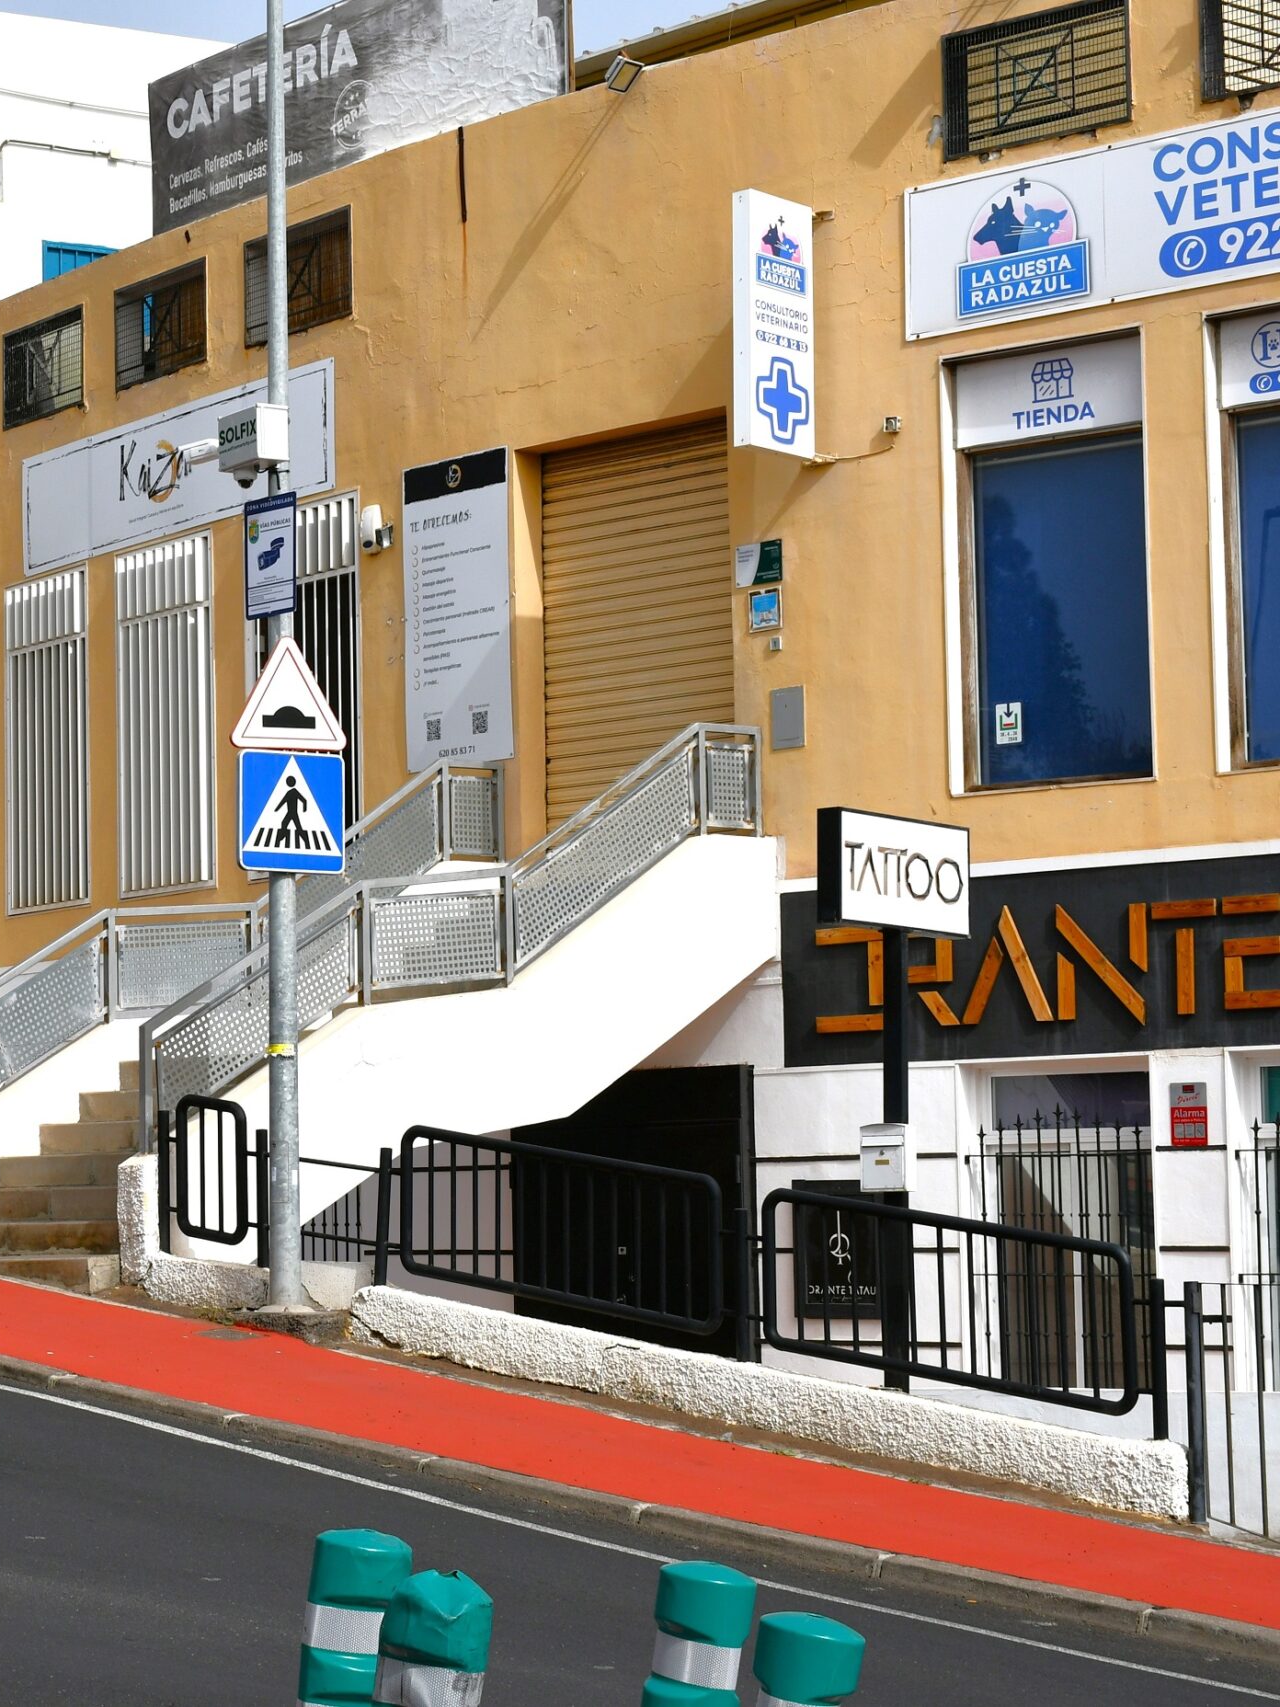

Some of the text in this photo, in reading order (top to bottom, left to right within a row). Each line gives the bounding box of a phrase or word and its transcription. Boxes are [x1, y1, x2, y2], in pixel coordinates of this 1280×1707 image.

[166, 24, 358, 138] CAFETERÍA
[1154, 166, 1280, 226] VETE
[760, 258, 801, 280] LA CUESTA
[760, 270, 800, 291] RADAZUL
[971, 254, 1072, 288] LA CUESTA
[971, 274, 1072, 307] RADAZUL
[755, 300, 808, 322] CONSULTORIO
[756, 312, 808, 334] VETERINARIO
[764, 332, 778, 345] 922
[1012, 402, 1096, 430] TIENDA
[219, 419, 256, 446] SOLFIX
[410, 509, 472, 533] TE OFRECEMOS:
[439, 748, 449, 758] 620
[451, 747, 458, 756] 85
[844, 840, 964, 904] TATTOO
[1174, 1109, 1205, 1118] Alarma
